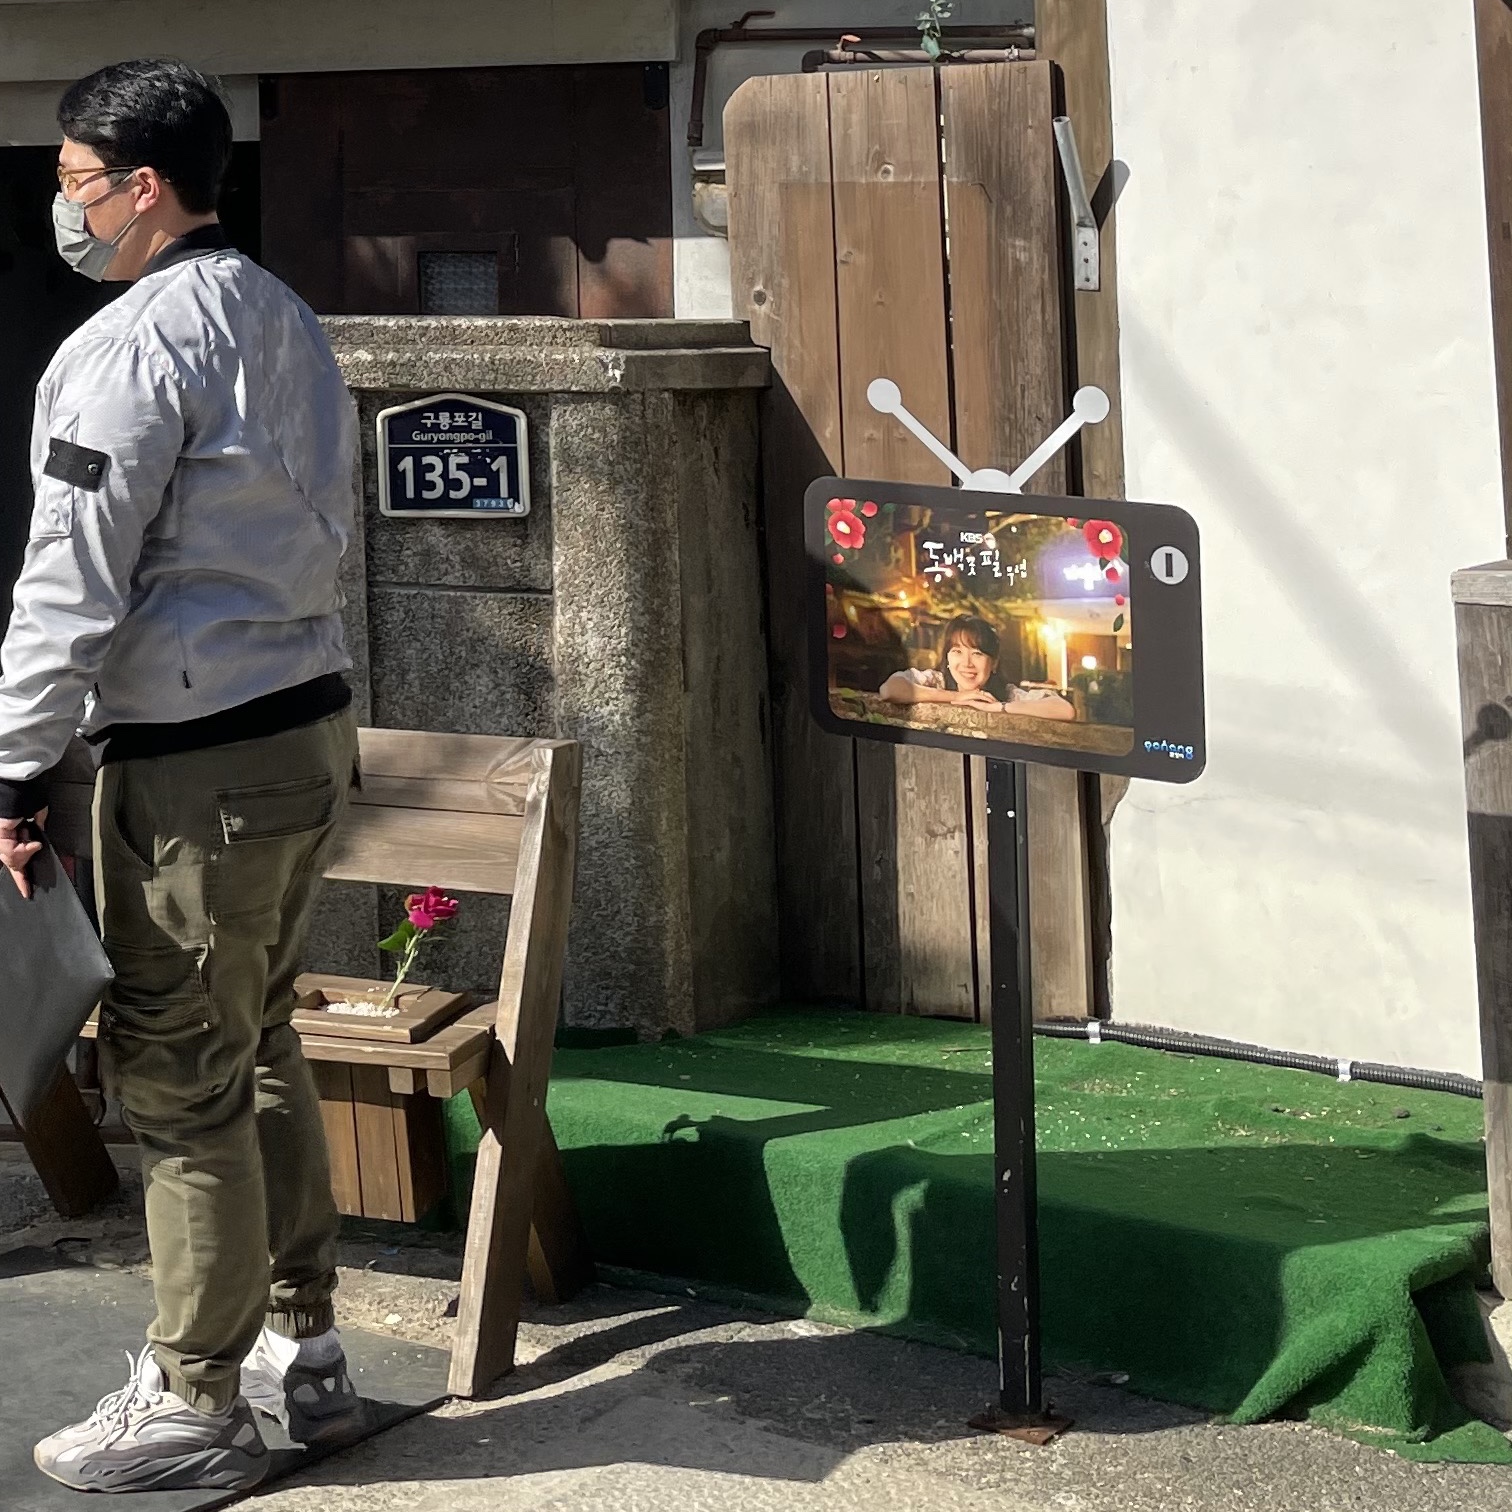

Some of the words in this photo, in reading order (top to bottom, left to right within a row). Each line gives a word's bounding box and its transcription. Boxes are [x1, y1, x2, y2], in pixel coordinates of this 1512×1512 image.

[420, 411, 483, 430] 구룡포길
[411, 429, 493, 444] Guryongpo-gil
[397, 455, 510, 500] 135-1
[960, 531, 984, 544] KBS
